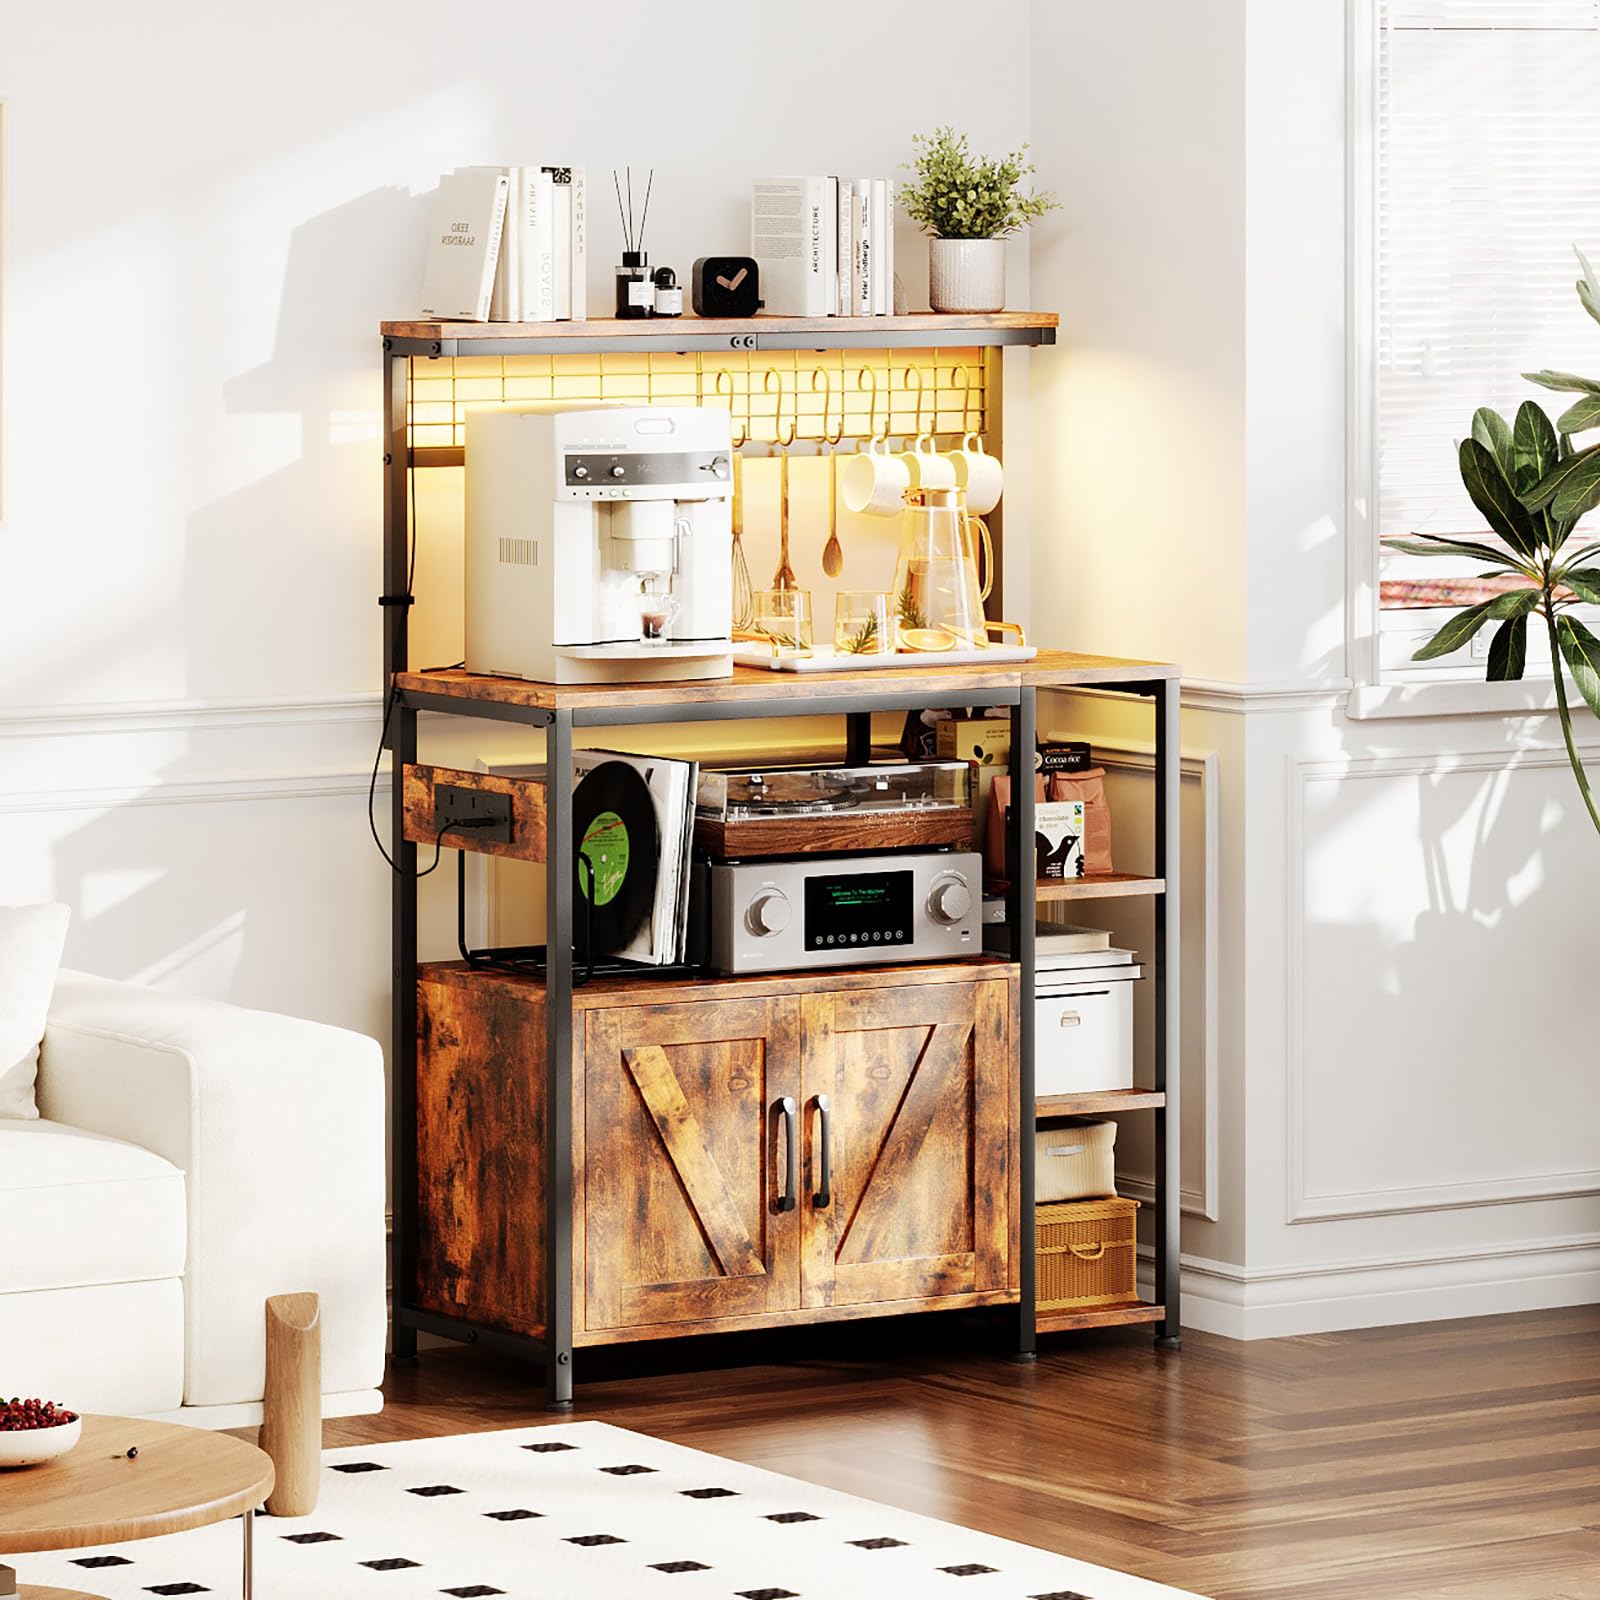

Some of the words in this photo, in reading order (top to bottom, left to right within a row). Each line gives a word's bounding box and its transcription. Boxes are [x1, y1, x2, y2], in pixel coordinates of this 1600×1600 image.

[812, 205, 820, 273] ARCHITECTURE
[862, 239, 870, 278] Lindbergh
[1045, 756, 1067, 764] Cocoa
[1068, 754, 1081, 763] rice
